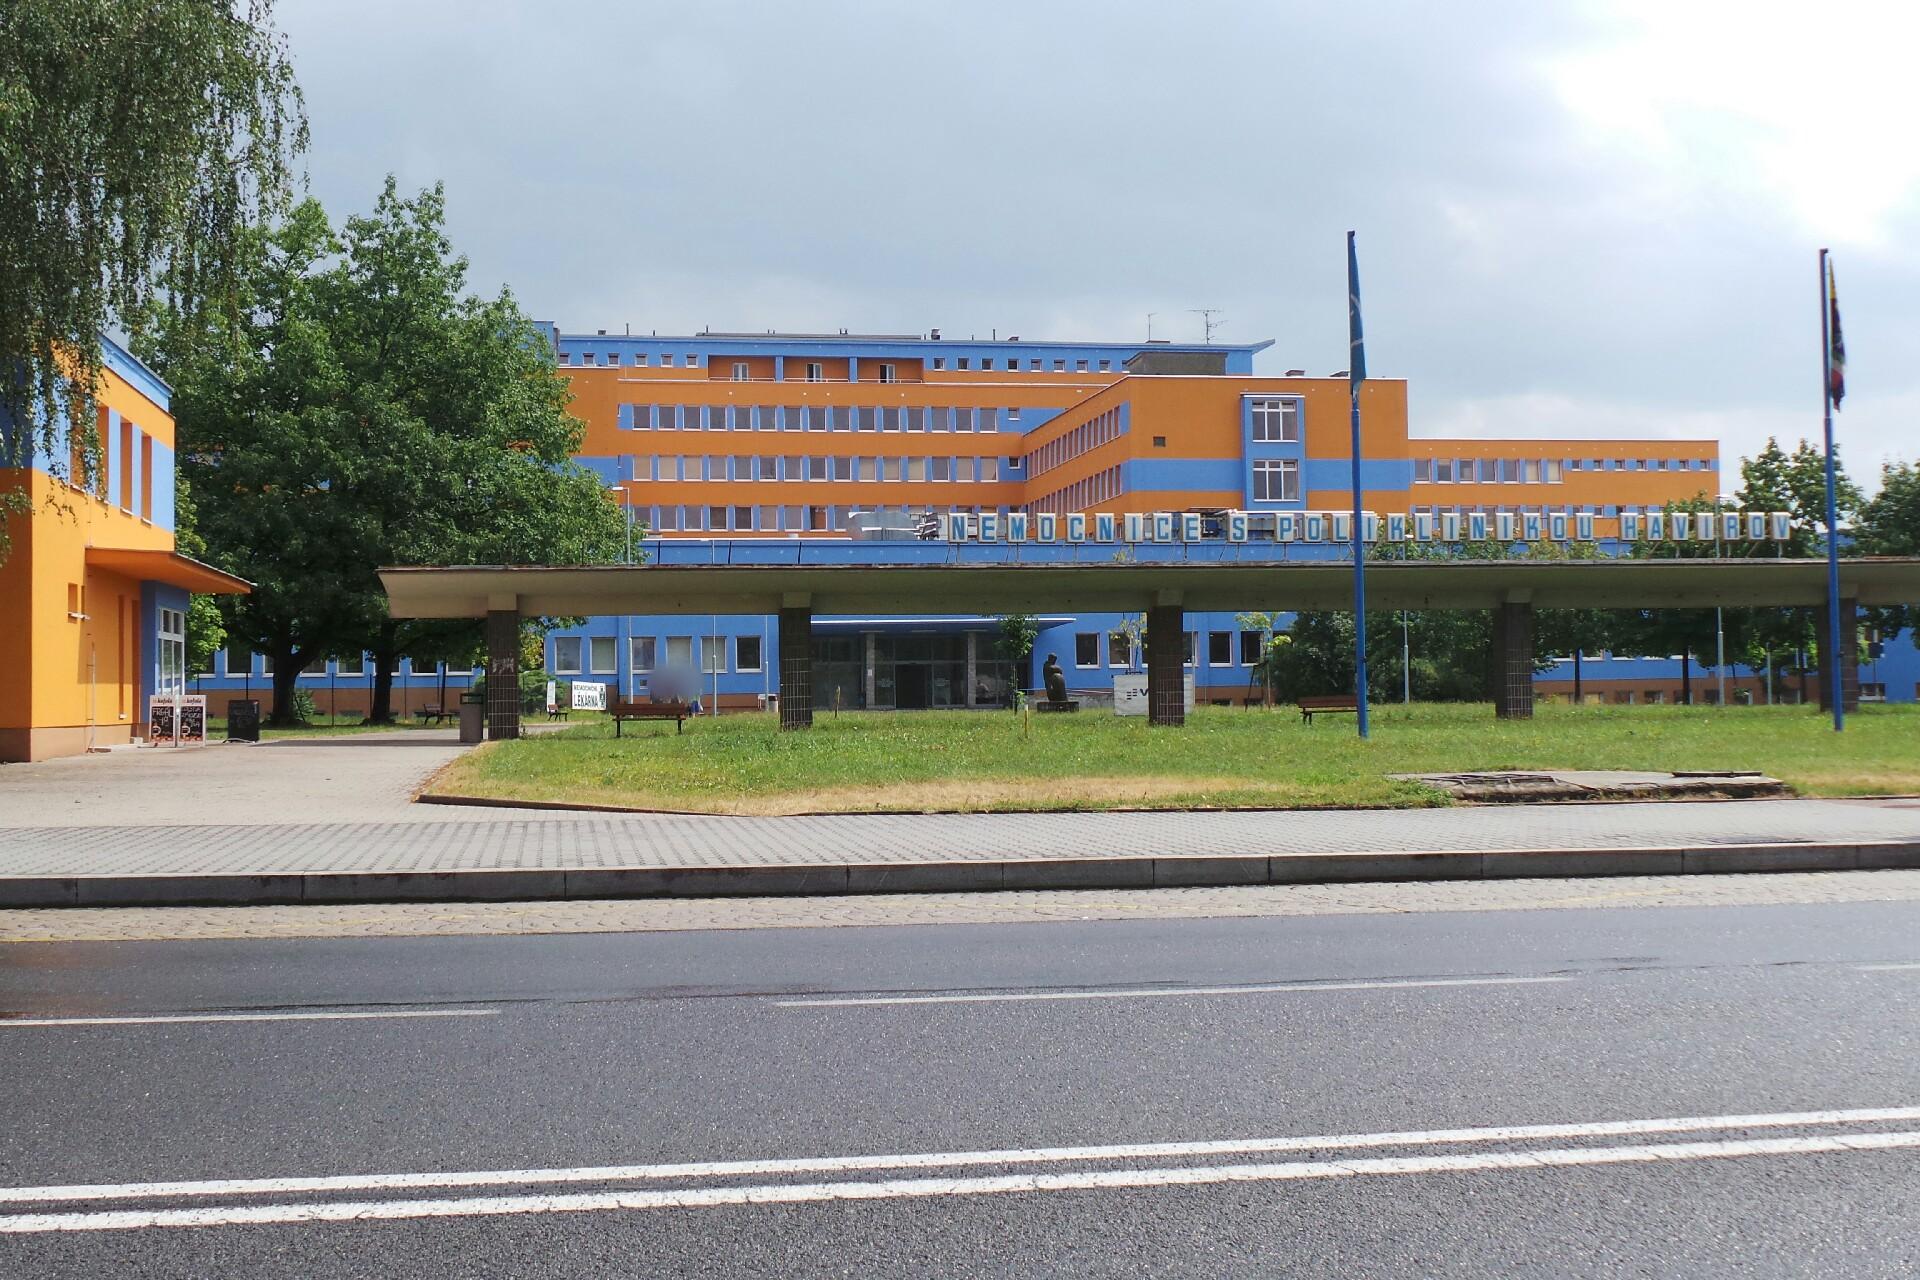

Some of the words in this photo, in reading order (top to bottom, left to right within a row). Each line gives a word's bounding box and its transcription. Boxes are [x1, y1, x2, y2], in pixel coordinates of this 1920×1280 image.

[951, 515, 1199, 541] NEMOCNICE
[1231, 515, 1246, 541] S
[1279, 515, 1591, 541] POLIKLINIKOU
